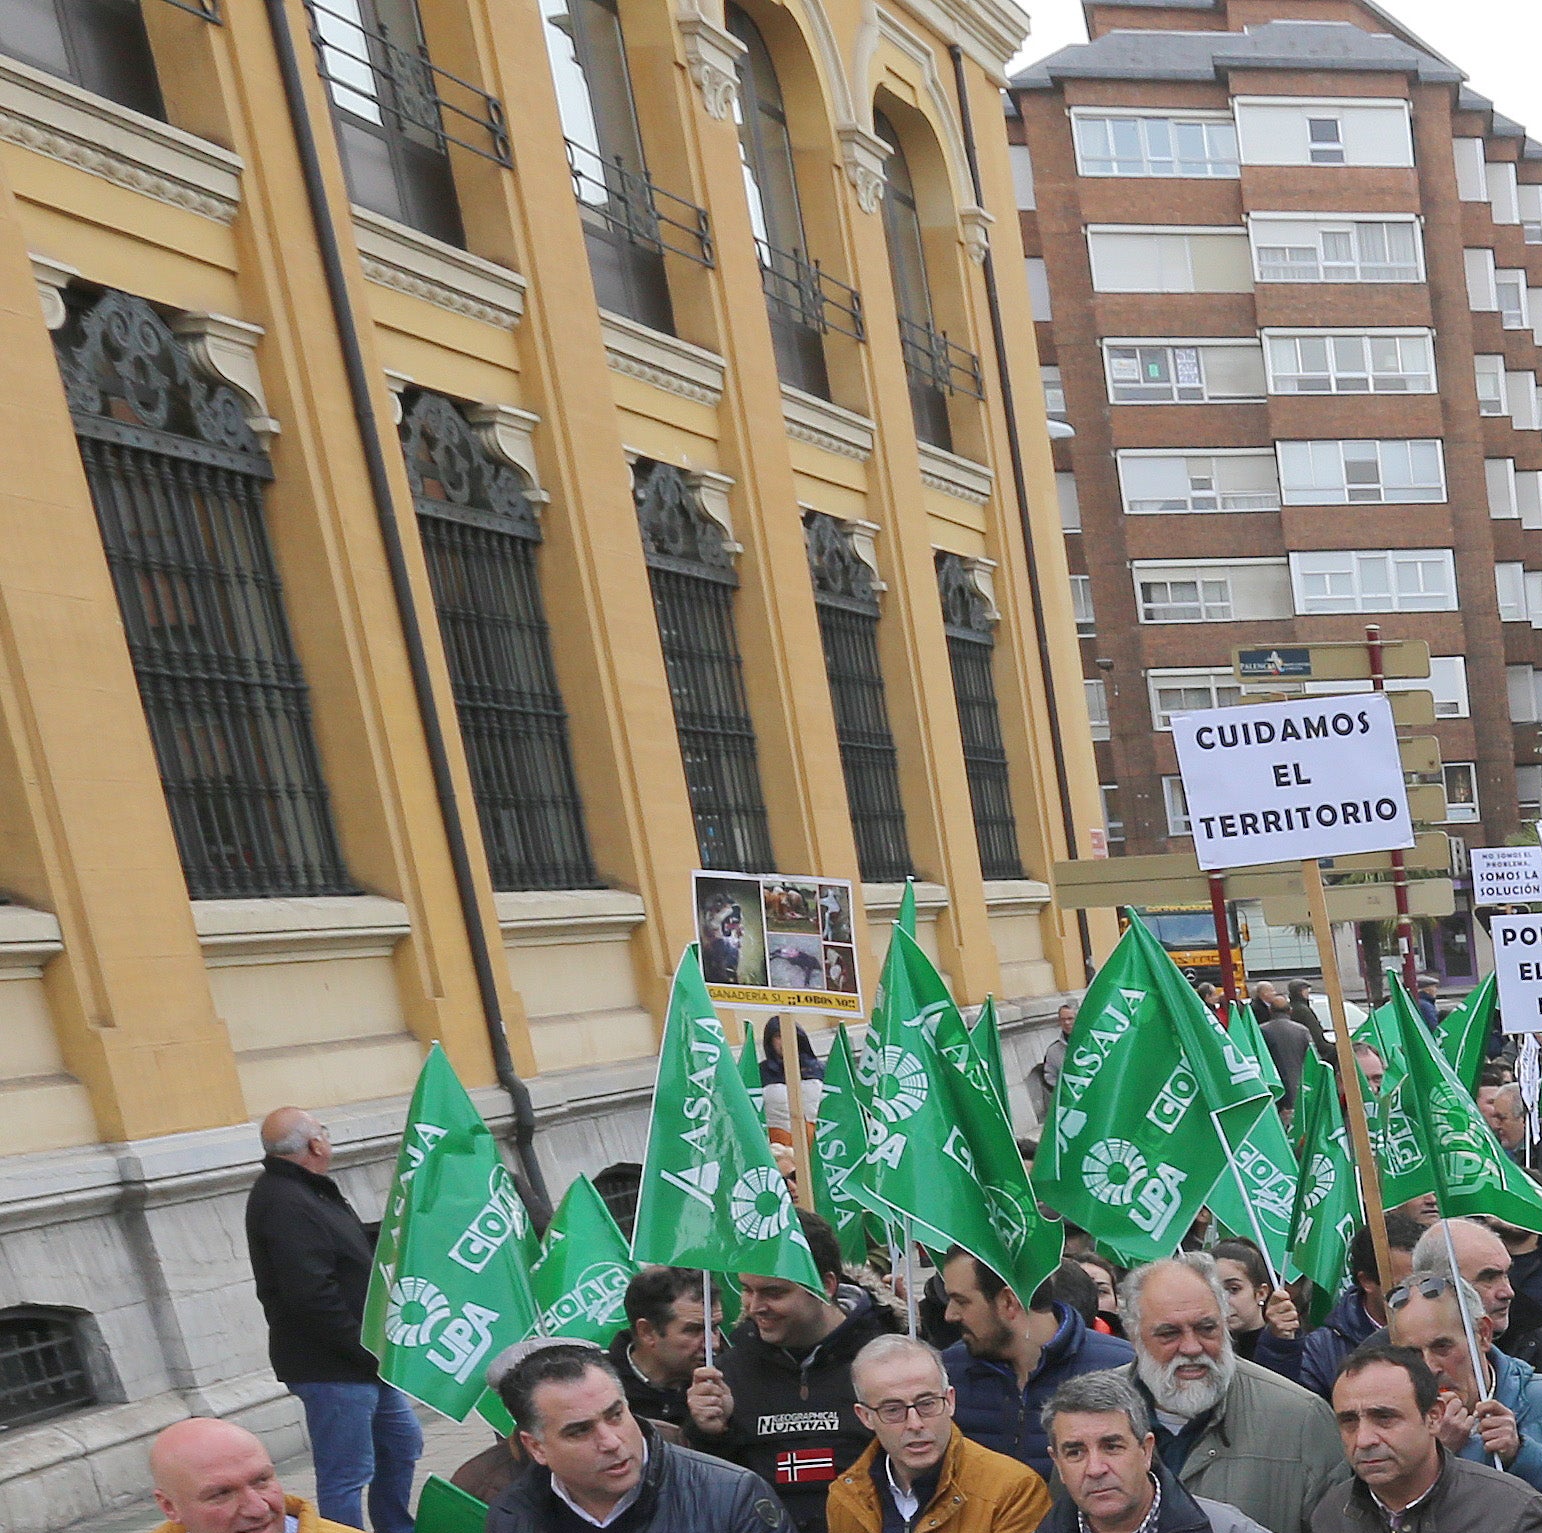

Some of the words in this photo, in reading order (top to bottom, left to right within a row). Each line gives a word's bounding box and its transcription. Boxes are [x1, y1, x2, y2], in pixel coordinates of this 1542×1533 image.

[1195, 710, 1371, 750] CUIDAMOS
[1273, 762, 1311, 787] EL
[1199, 797, 1398, 840] TERRITORIO
[1480, 871, 1520, 882] SOMOS
[1525, 870, 1539, 880] LA
[1480, 884, 1541, 896] SOLUCIÓN
[1061, 986, 1149, 1102] ASAJA
[679, 1016, 728, 1155] ASAJA
[865, 1113, 909, 1170] PA
[814, 1117, 857, 1231] ASAJA
[1234, 1142, 1298, 1205] COA
[1128, 1161, 1189, 1242] UPA
[425, 1301, 501, 1386] UPA
[758, 1416, 839, 1435] NORWAY
[774, 1412, 839, 1423] GEOGRAPHICAL
